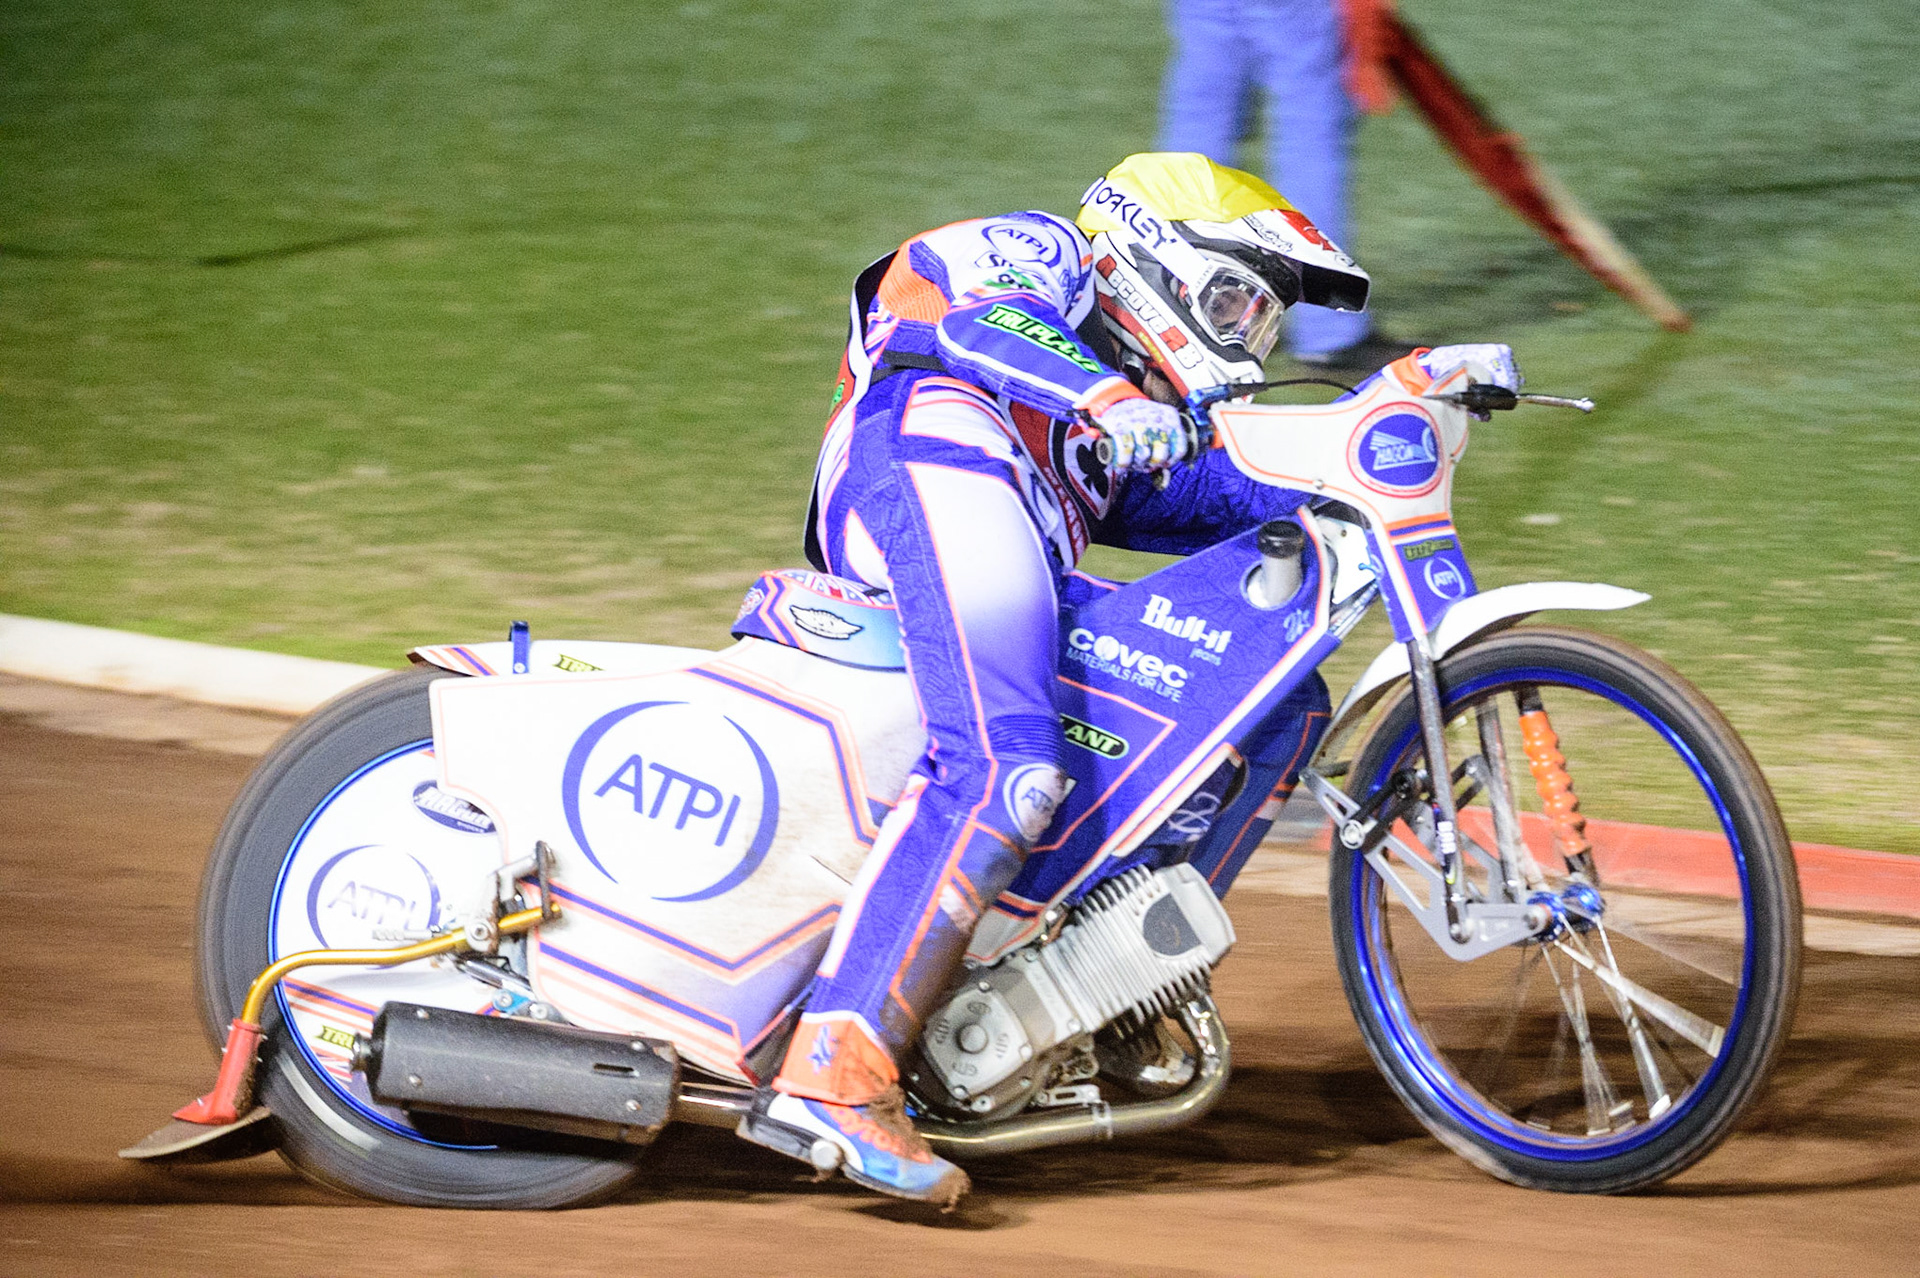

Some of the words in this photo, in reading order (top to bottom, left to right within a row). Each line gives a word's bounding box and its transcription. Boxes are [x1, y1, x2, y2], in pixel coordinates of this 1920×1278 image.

[995, 227, 1049, 255] ATPI
[1096, 186, 1167, 249] OAKLEY
[1066, 647, 1131, 681] MATERIALS
[1130, 671, 1158, 691] FOR
[1155, 678, 1183, 703] LIFE
[593, 753, 741, 847] ATPI
